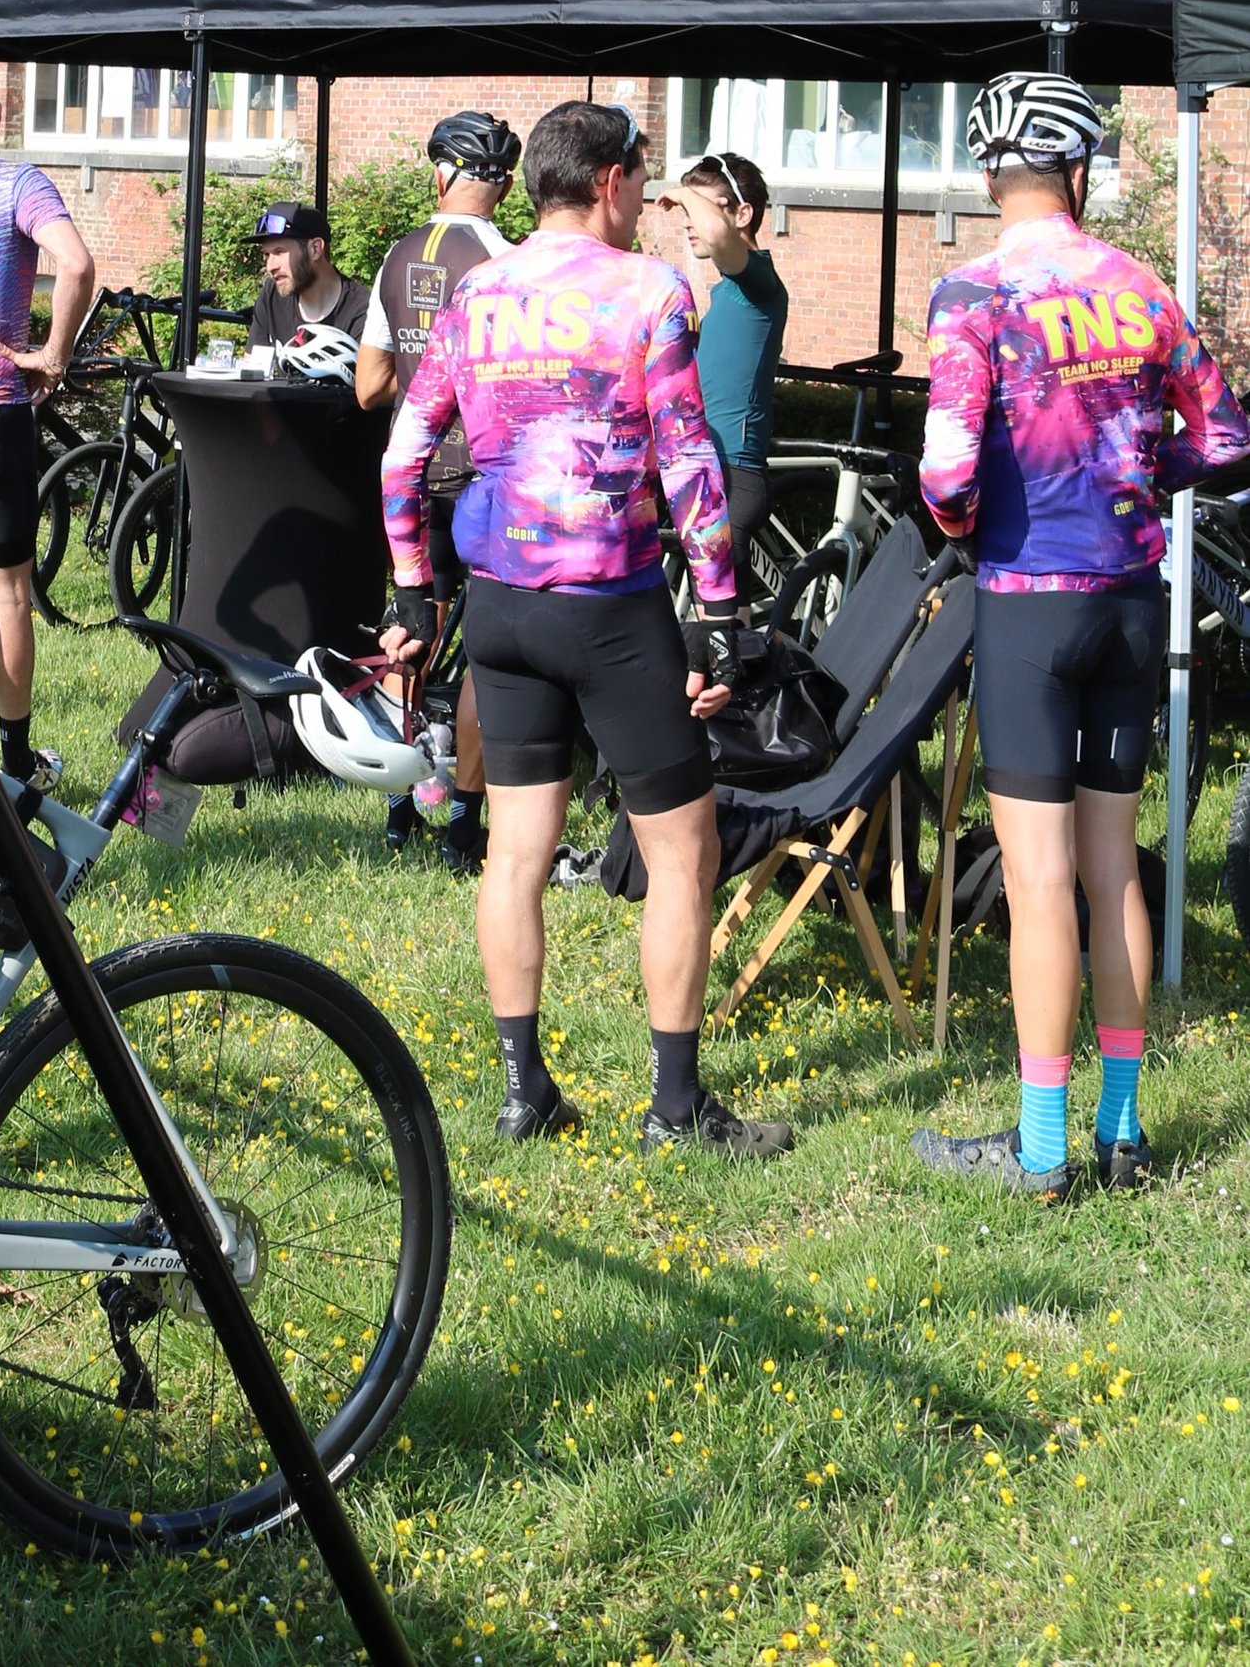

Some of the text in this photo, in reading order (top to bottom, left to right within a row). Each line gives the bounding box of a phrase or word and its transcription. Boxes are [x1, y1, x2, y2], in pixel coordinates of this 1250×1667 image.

[1029, 141, 1057, 150] LAZER
[468, 290, 592, 358] TNS
[1026, 291, 1156, 360] TNS
[475, 359, 572, 375] TEAM NO SLEEP
[1059, 356, 1145, 379] TEAM NO SLEEP
[506, 525, 538, 542] GOBIK
[502, 1037, 515, 1051] ME
[507, 1059, 521, 1090] CATCH
[376, 1062, 416, 1142] BLACK INC
[133, 1255, 184, 1270] FACTOR
